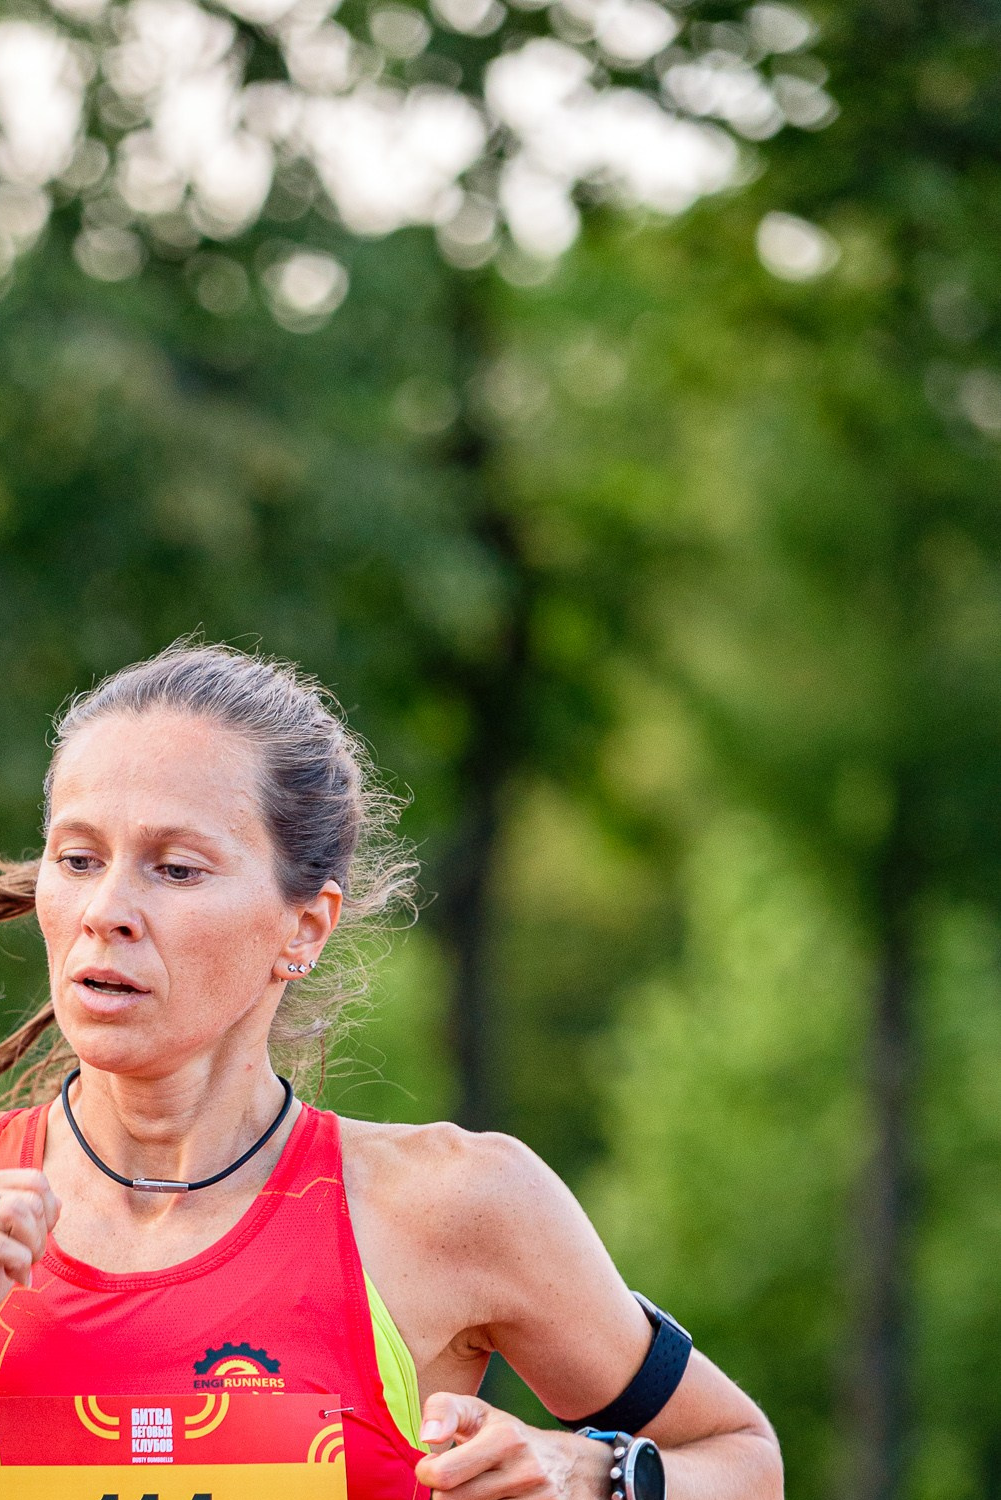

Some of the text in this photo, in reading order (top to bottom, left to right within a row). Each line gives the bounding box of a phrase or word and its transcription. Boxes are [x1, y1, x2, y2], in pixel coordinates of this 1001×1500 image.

[193, 1378, 285, 1389] ENGIRUNNERS
[131, 1408, 172, 1425] БИТВА
[131, 1426, 172, 1438] БЕГОВЫХ
[131, 1439, 173, 1453] КЛУБОВ
